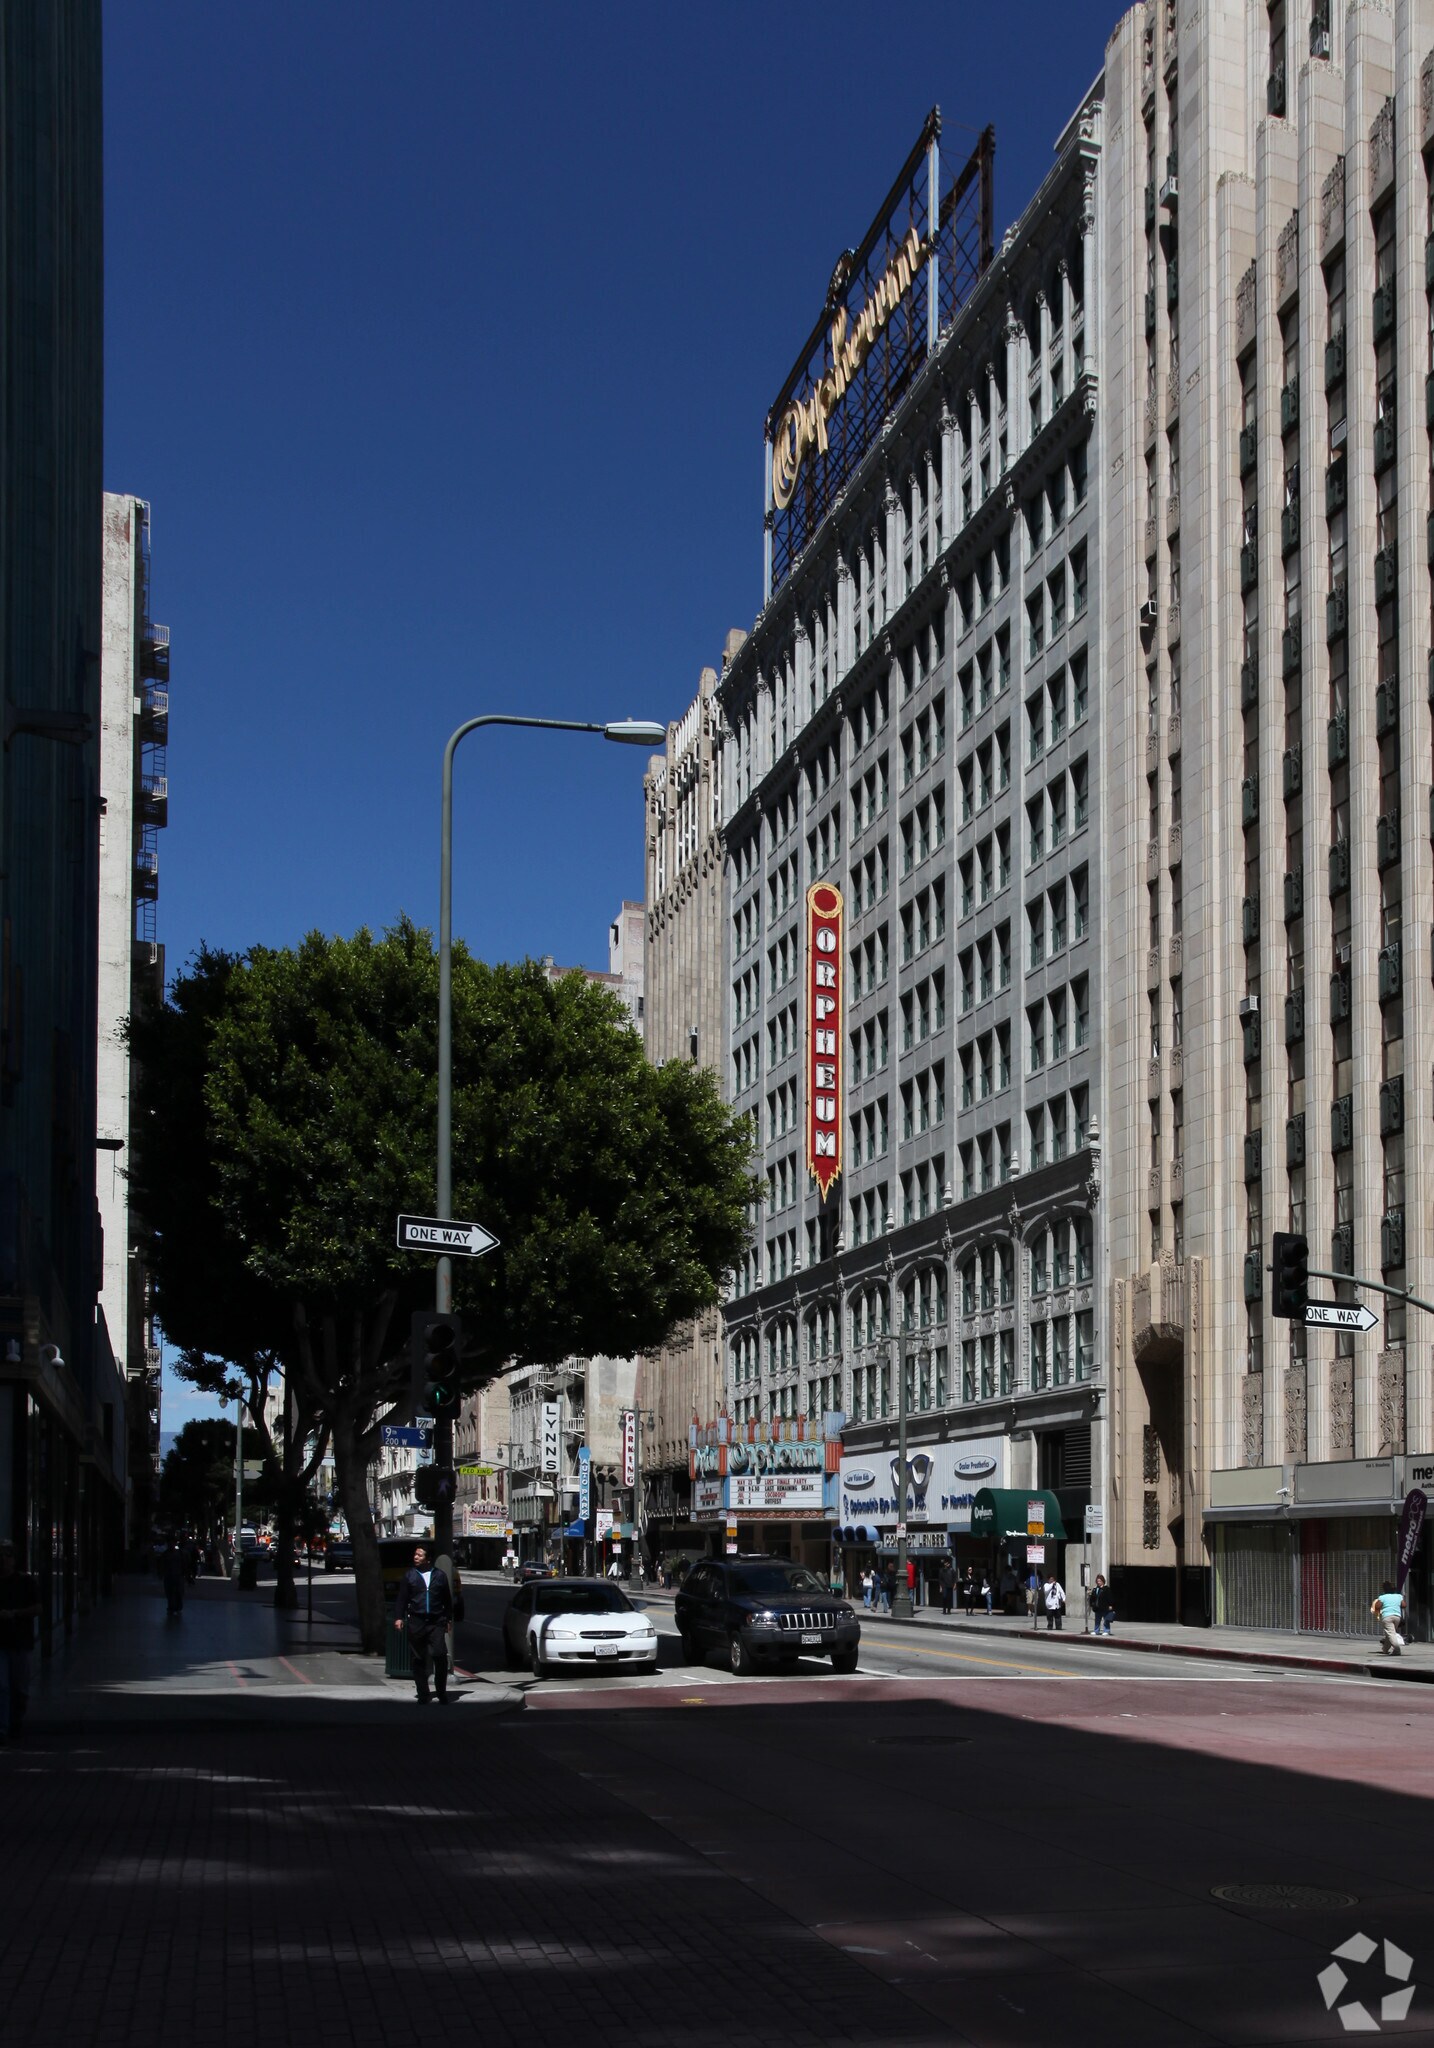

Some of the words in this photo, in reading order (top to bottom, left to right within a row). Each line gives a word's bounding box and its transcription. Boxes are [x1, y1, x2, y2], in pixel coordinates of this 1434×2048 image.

[773, 227, 925, 510] Orpheum
[816, 926, 836, 1157] ORPHEUM
[410, 1226, 437, 1241] ONE
[442, 1230, 470, 1245] WAY
[1306, 1307, 1330, 1321] ONE
[1336, 1310, 1360, 1324] WAY
[385, 1437, 399, 1446] 200
[545, 1405, 557, 1471] LYNNS
[729, 1439, 820, 1480] Orpheum
[581, 1459, 589, 1485] AUTO
[469, 1502, 508, 1515] RIALTO
[581, 1490, 589, 1516] PARK
[973, 1505, 994, 1519] Orpheum
[919, 1533, 945, 1546] LENSES
